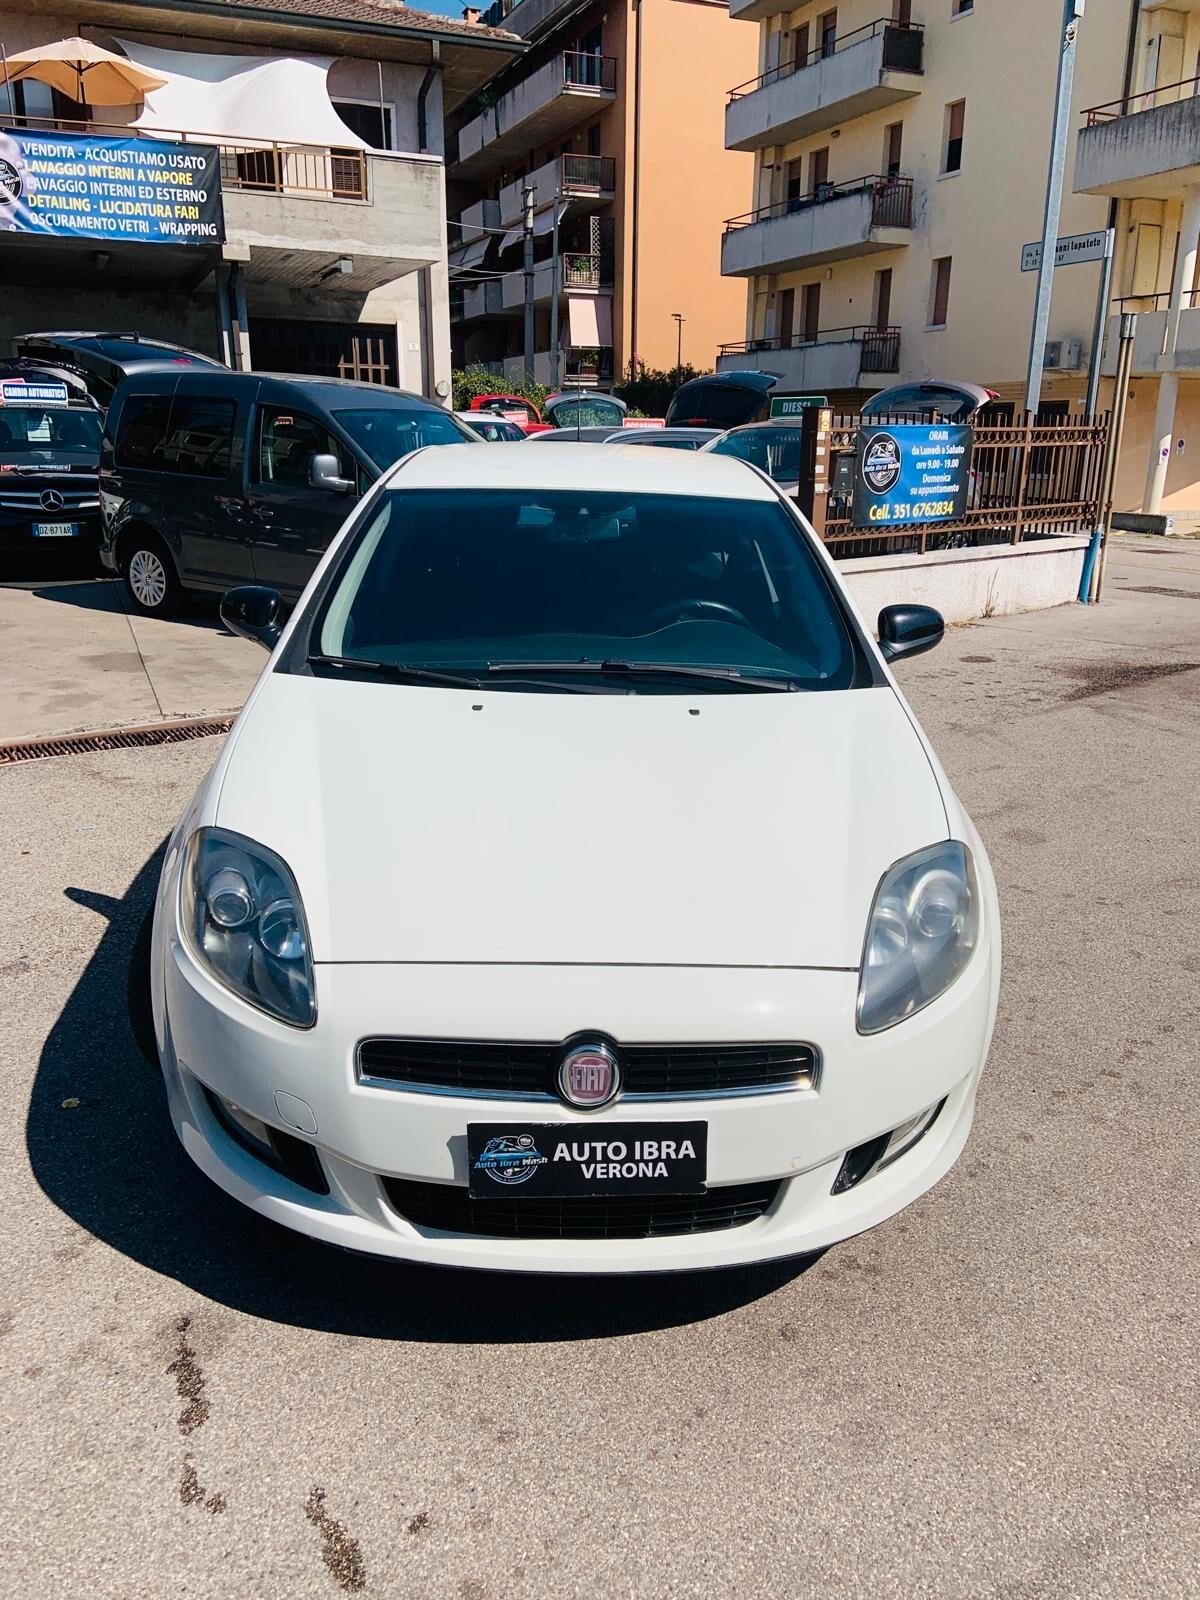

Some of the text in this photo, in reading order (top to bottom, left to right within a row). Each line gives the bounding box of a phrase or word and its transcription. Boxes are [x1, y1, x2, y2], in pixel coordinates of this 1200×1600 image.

[22, 142, 75, 159] VENDITA
[85, 147, 166, 167] ACQUISTIAMO
[168, 154, 206, 170] USATO
[24, 159, 193, 186] LAVAGGIO INTERNI A VAPORE
[26, 177, 207, 203] LAVAGGIO INTERNI ED ESTERNO
[28, 194, 91, 212] DETAILING
[100, 199, 173, 218] LUCIDATURA
[174, 205, 199, 219] FARI
[29, 212, 117, 231] OSCURAMENTO
[118, 219, 149, 233] VETRI
[159, 222, 217, 236] WRAPPING
[4, 386, 66, 399] CAMBIO AUTOMATICO
[929, 430, 949, 441] ORARI
[911, 444, 920, 456] da
[946, 444, 965, 454] Sabato
[916, 461, 927, 470] ore
[927, 459, 941, 469] 9.00
[944, 459, 959, 468] 19.00
[922, 473, 951, 483] Domenica
[910, 484, 960, 496] su appuntamento
[869, 501, 954, 520] Cell. 351 6762834
[40, 526, 49, 534] DZ
[572, 1064, 608, 1091] FIAT
[552, 1140, 696, 1162] AUTO IBRA
[522, 1156, 548, 1166] Wash
[580, 1162, 669, 1179] VERONA
